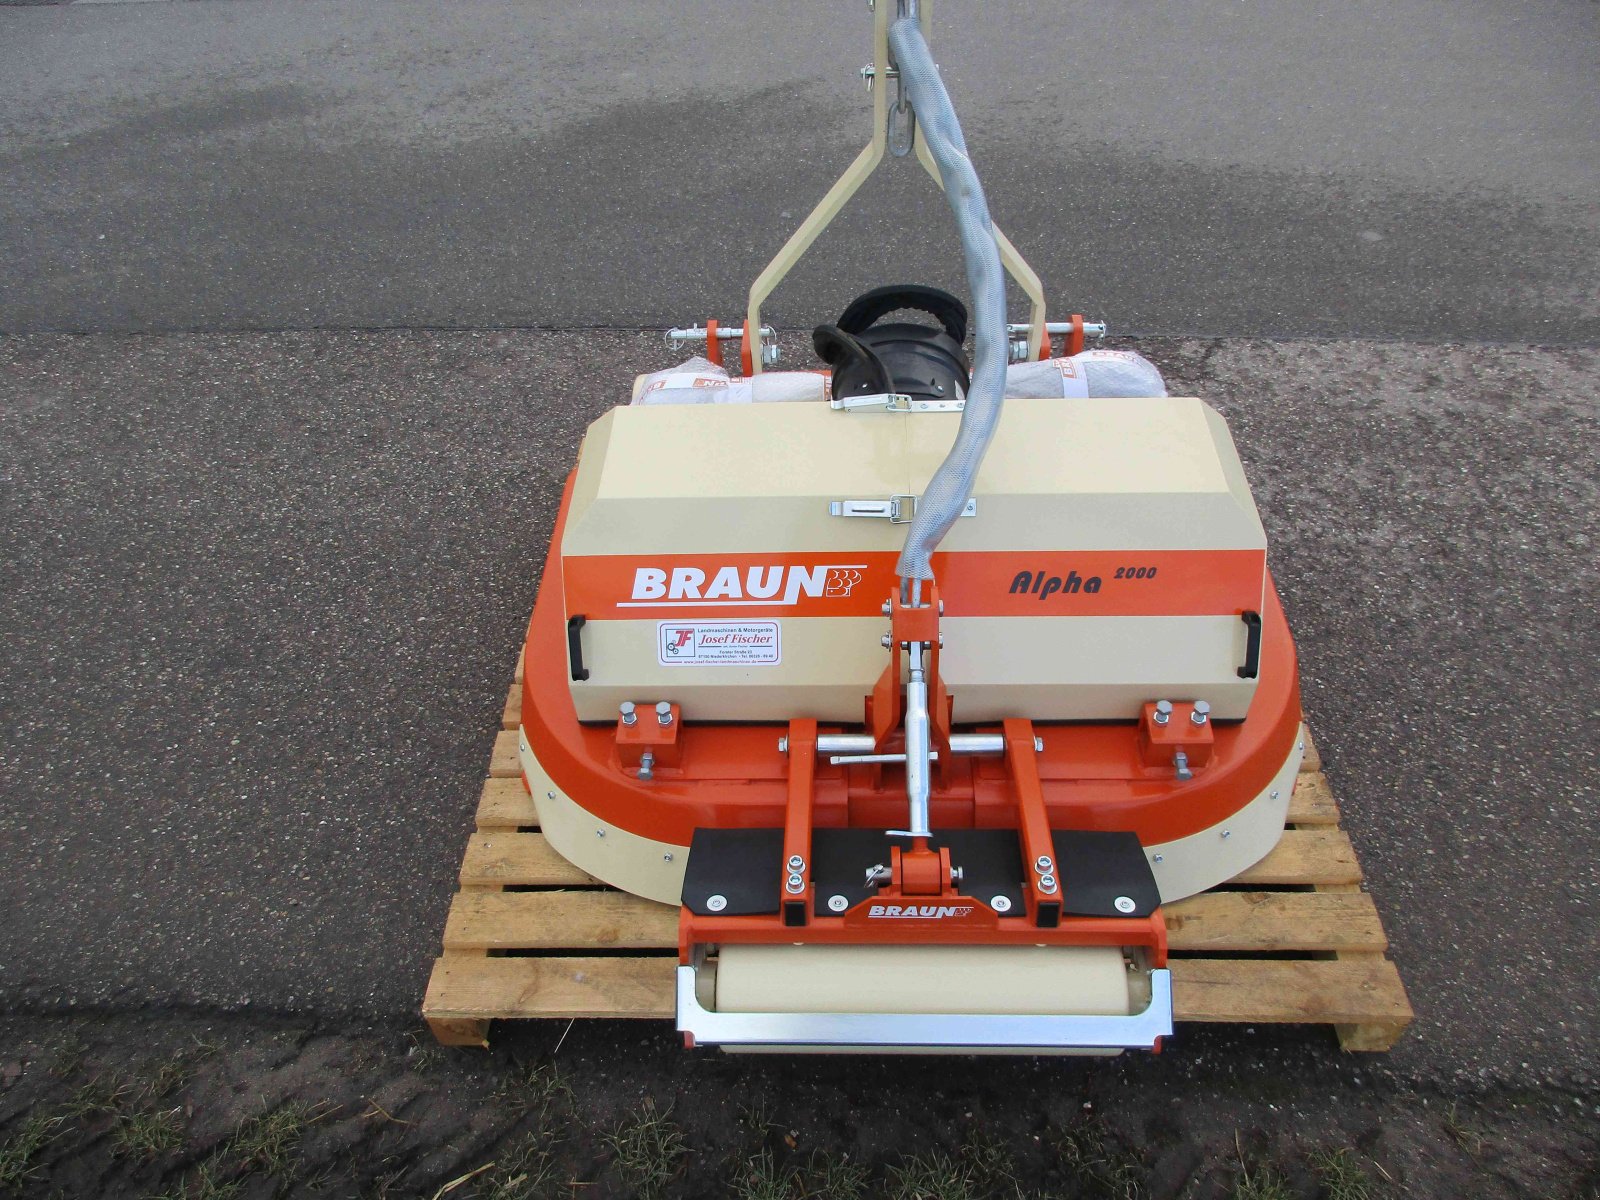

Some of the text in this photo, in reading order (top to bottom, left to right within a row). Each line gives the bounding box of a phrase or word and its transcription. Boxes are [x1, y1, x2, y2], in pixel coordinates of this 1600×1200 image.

[631, 565, 828, 605] BRAUN
[1009, 566, 1157, 600] Alpha 2000
[698, 634, 773, 645] Josef Fischer
[868, 905, 956, 918] BRAUN
